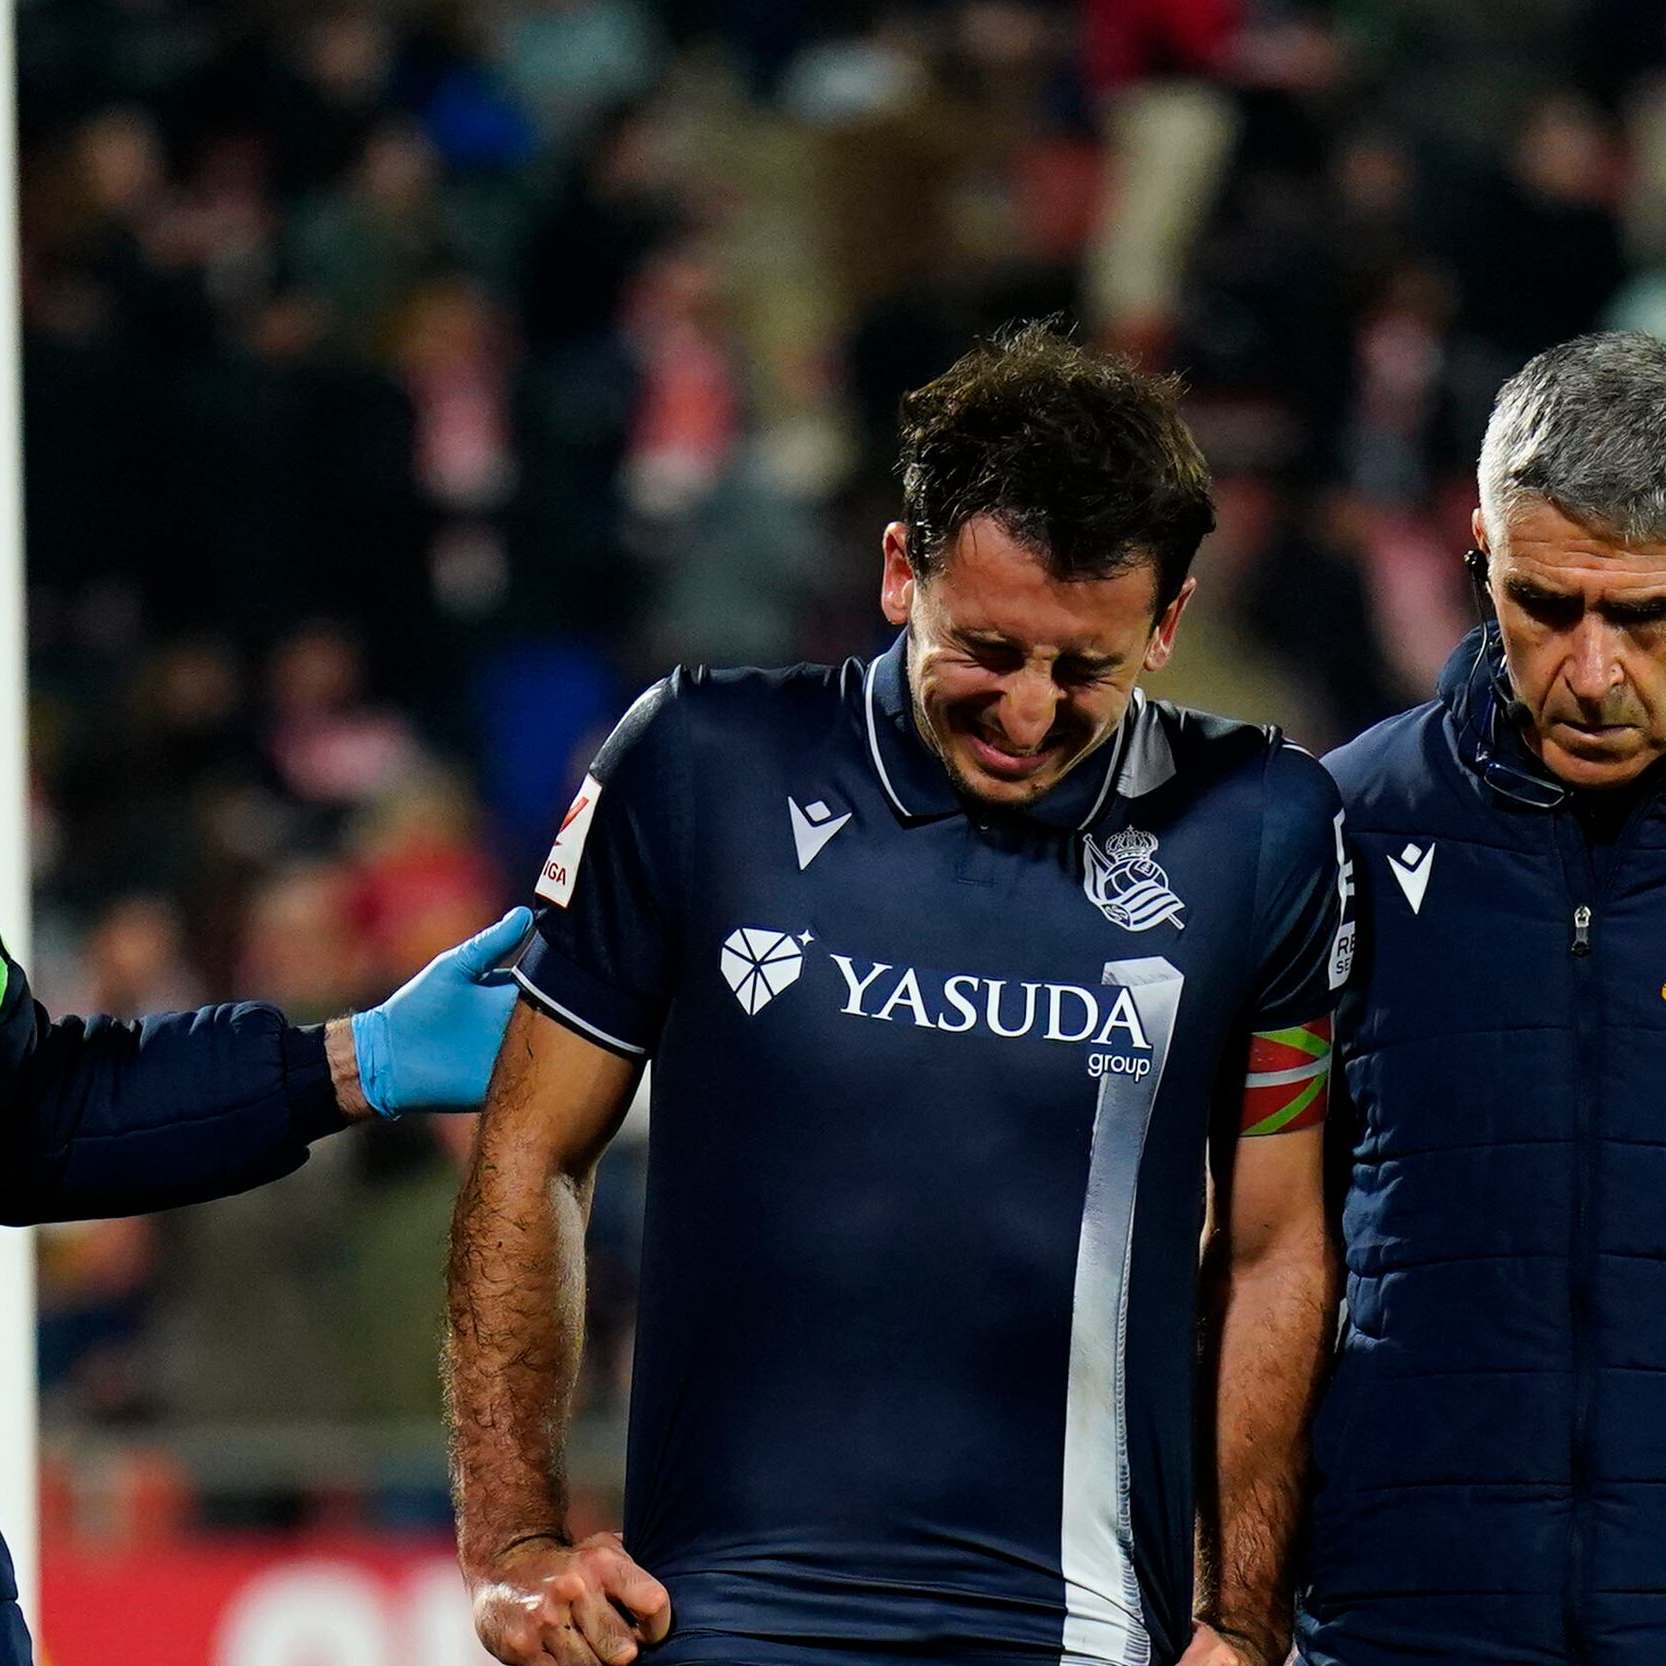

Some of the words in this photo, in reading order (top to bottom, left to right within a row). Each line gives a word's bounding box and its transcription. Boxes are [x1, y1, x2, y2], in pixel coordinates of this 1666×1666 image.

[543, 860, 567, 886] IGA
[830, 953, 1152, 1049] YASUDA
[1087, 1052, 1150, 1082] group
